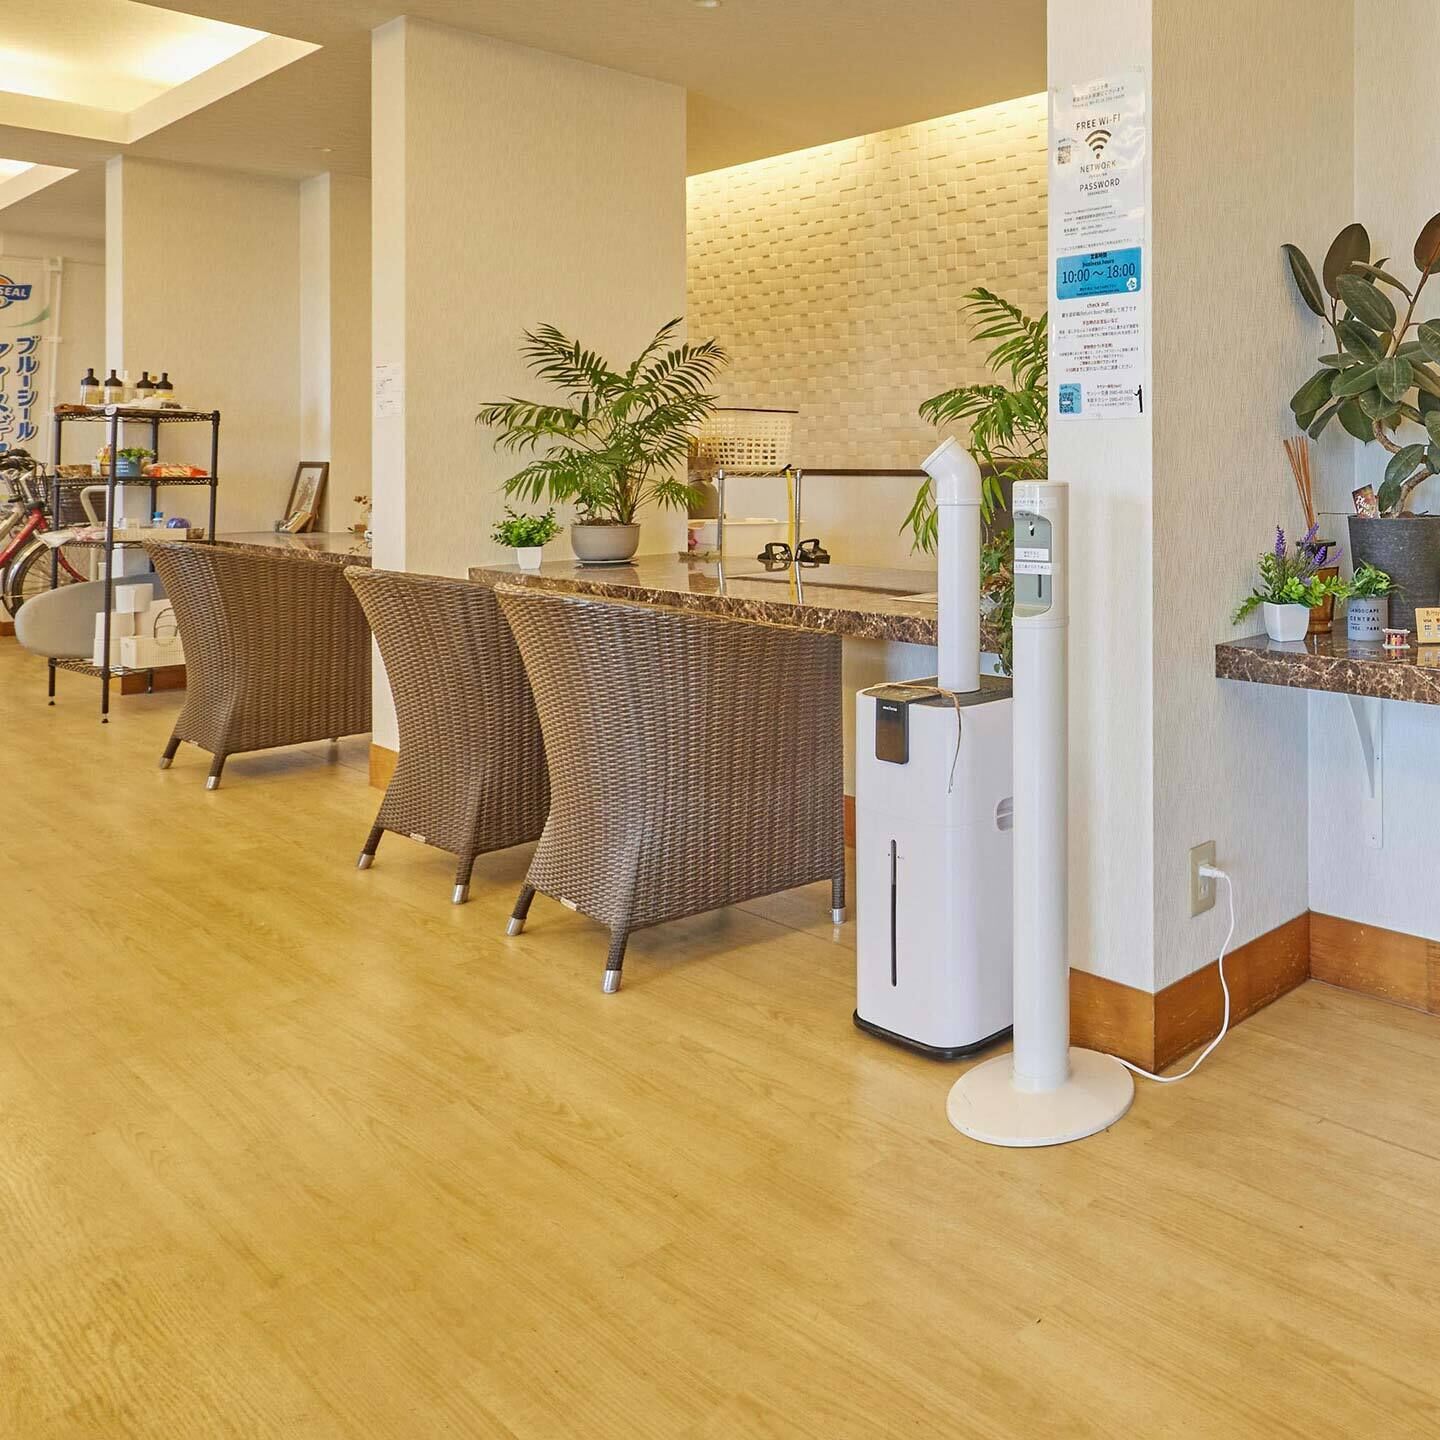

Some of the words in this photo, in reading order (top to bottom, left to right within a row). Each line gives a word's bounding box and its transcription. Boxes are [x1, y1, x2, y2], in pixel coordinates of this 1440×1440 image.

[1076, 118, 1096, 131] FREE
[1080, 160, 1116, 173] NETWORK
[1079, 178, 1120, 192] PASSWORD
[1062, 268, 1090, 284] 10:00
[1107, 263, 1136, 279] 18:00
[16, 335, 40, 440] ブルーシール
